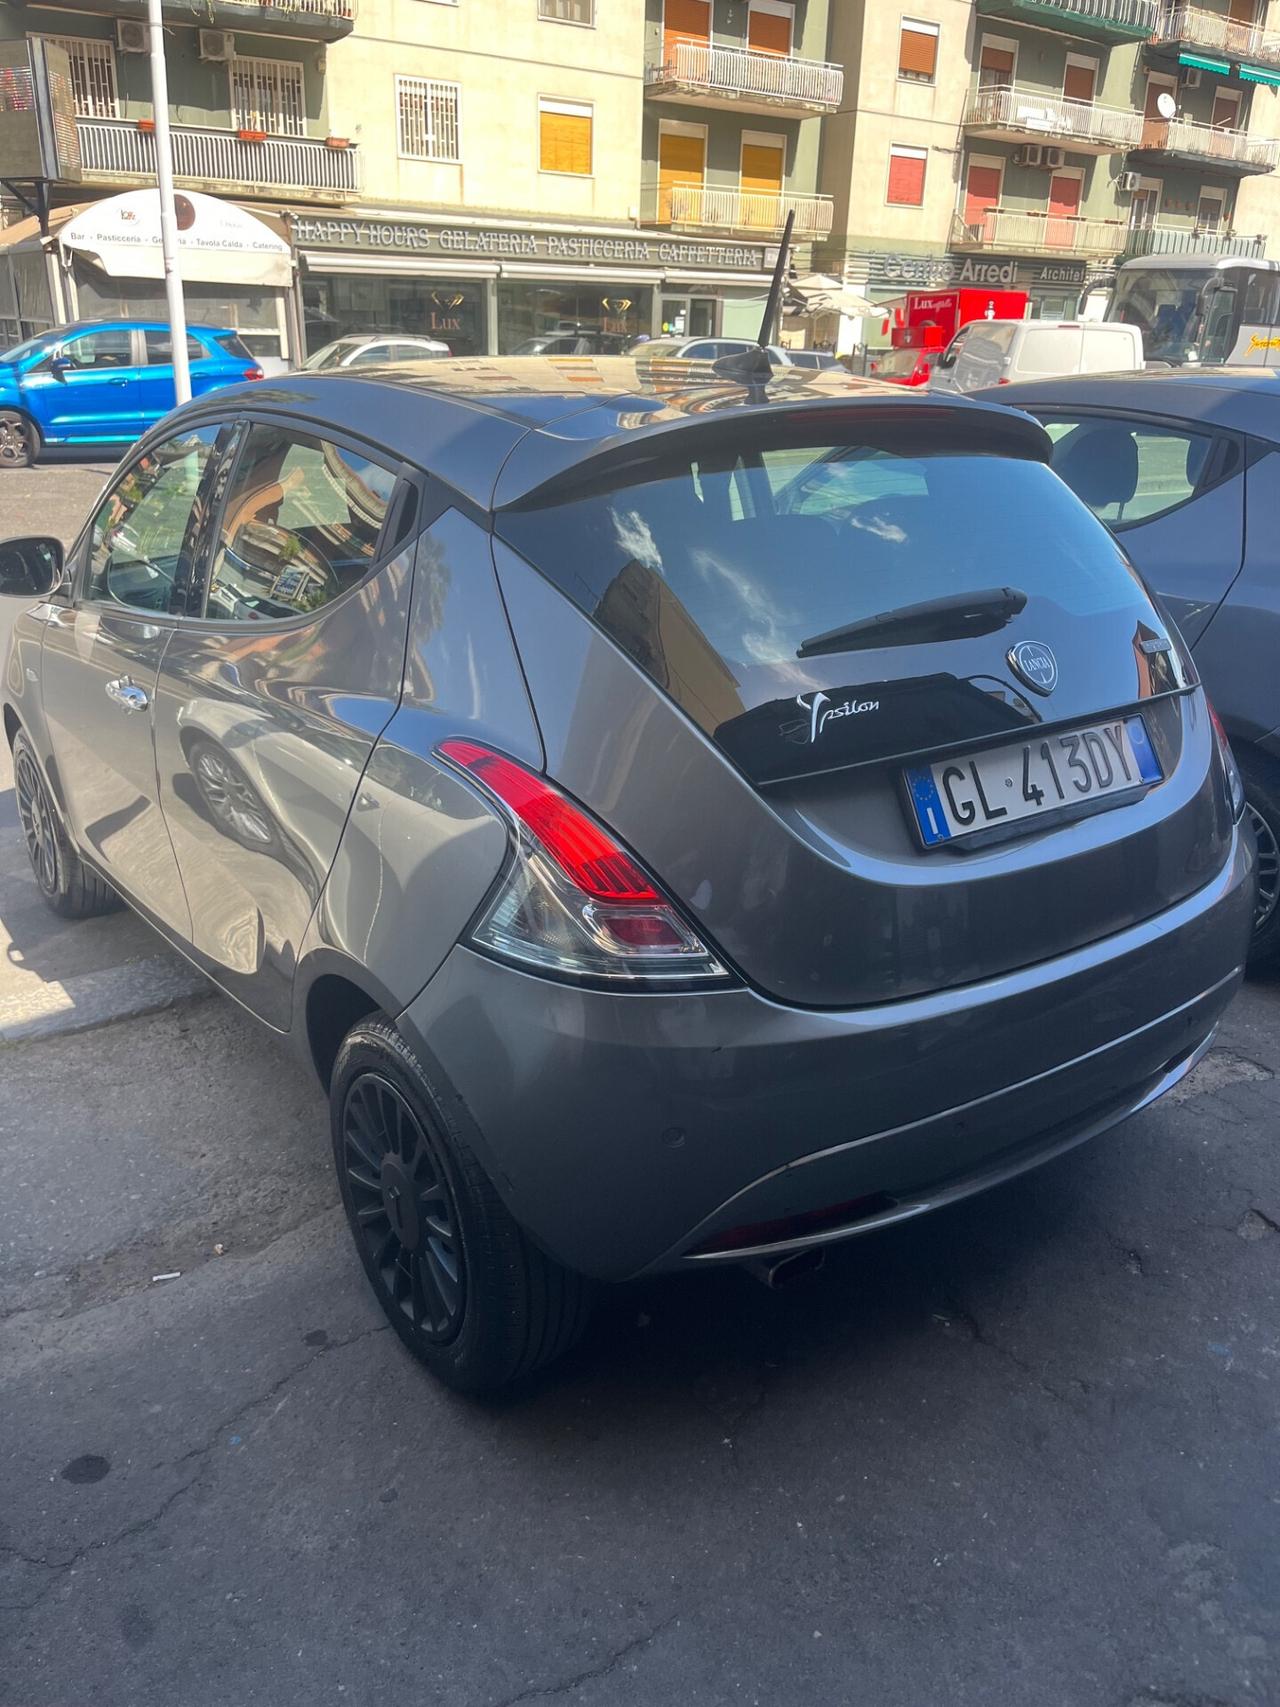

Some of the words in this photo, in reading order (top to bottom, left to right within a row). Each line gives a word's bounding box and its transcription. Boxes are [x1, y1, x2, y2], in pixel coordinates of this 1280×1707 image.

[70, 232, 85, 240] Bar
[96, 233, 141, 243] Pasticceria
[196, 238, 220, 247] Tavola
[221, 239, 243, 248] Calda
[252, 241, 283, 252] Catering
[296, 219, 365, 241] HAPPY
[368, 224, 430, 248] HOURS
[439, 229, 538, 253] GELATERIA
[546, 236, 651, 260] PASTICCERIA
[659, 243, 757, 266] CAFFETTERIA
[959, 258, 1019, 283] Arredi
[913, 297, 933, 310] Lux
[431, 311, 460, 330] Lux
[1023, 656, 1051, 671] LANCIA
[796, 692, 880, 743] Ypsilon
